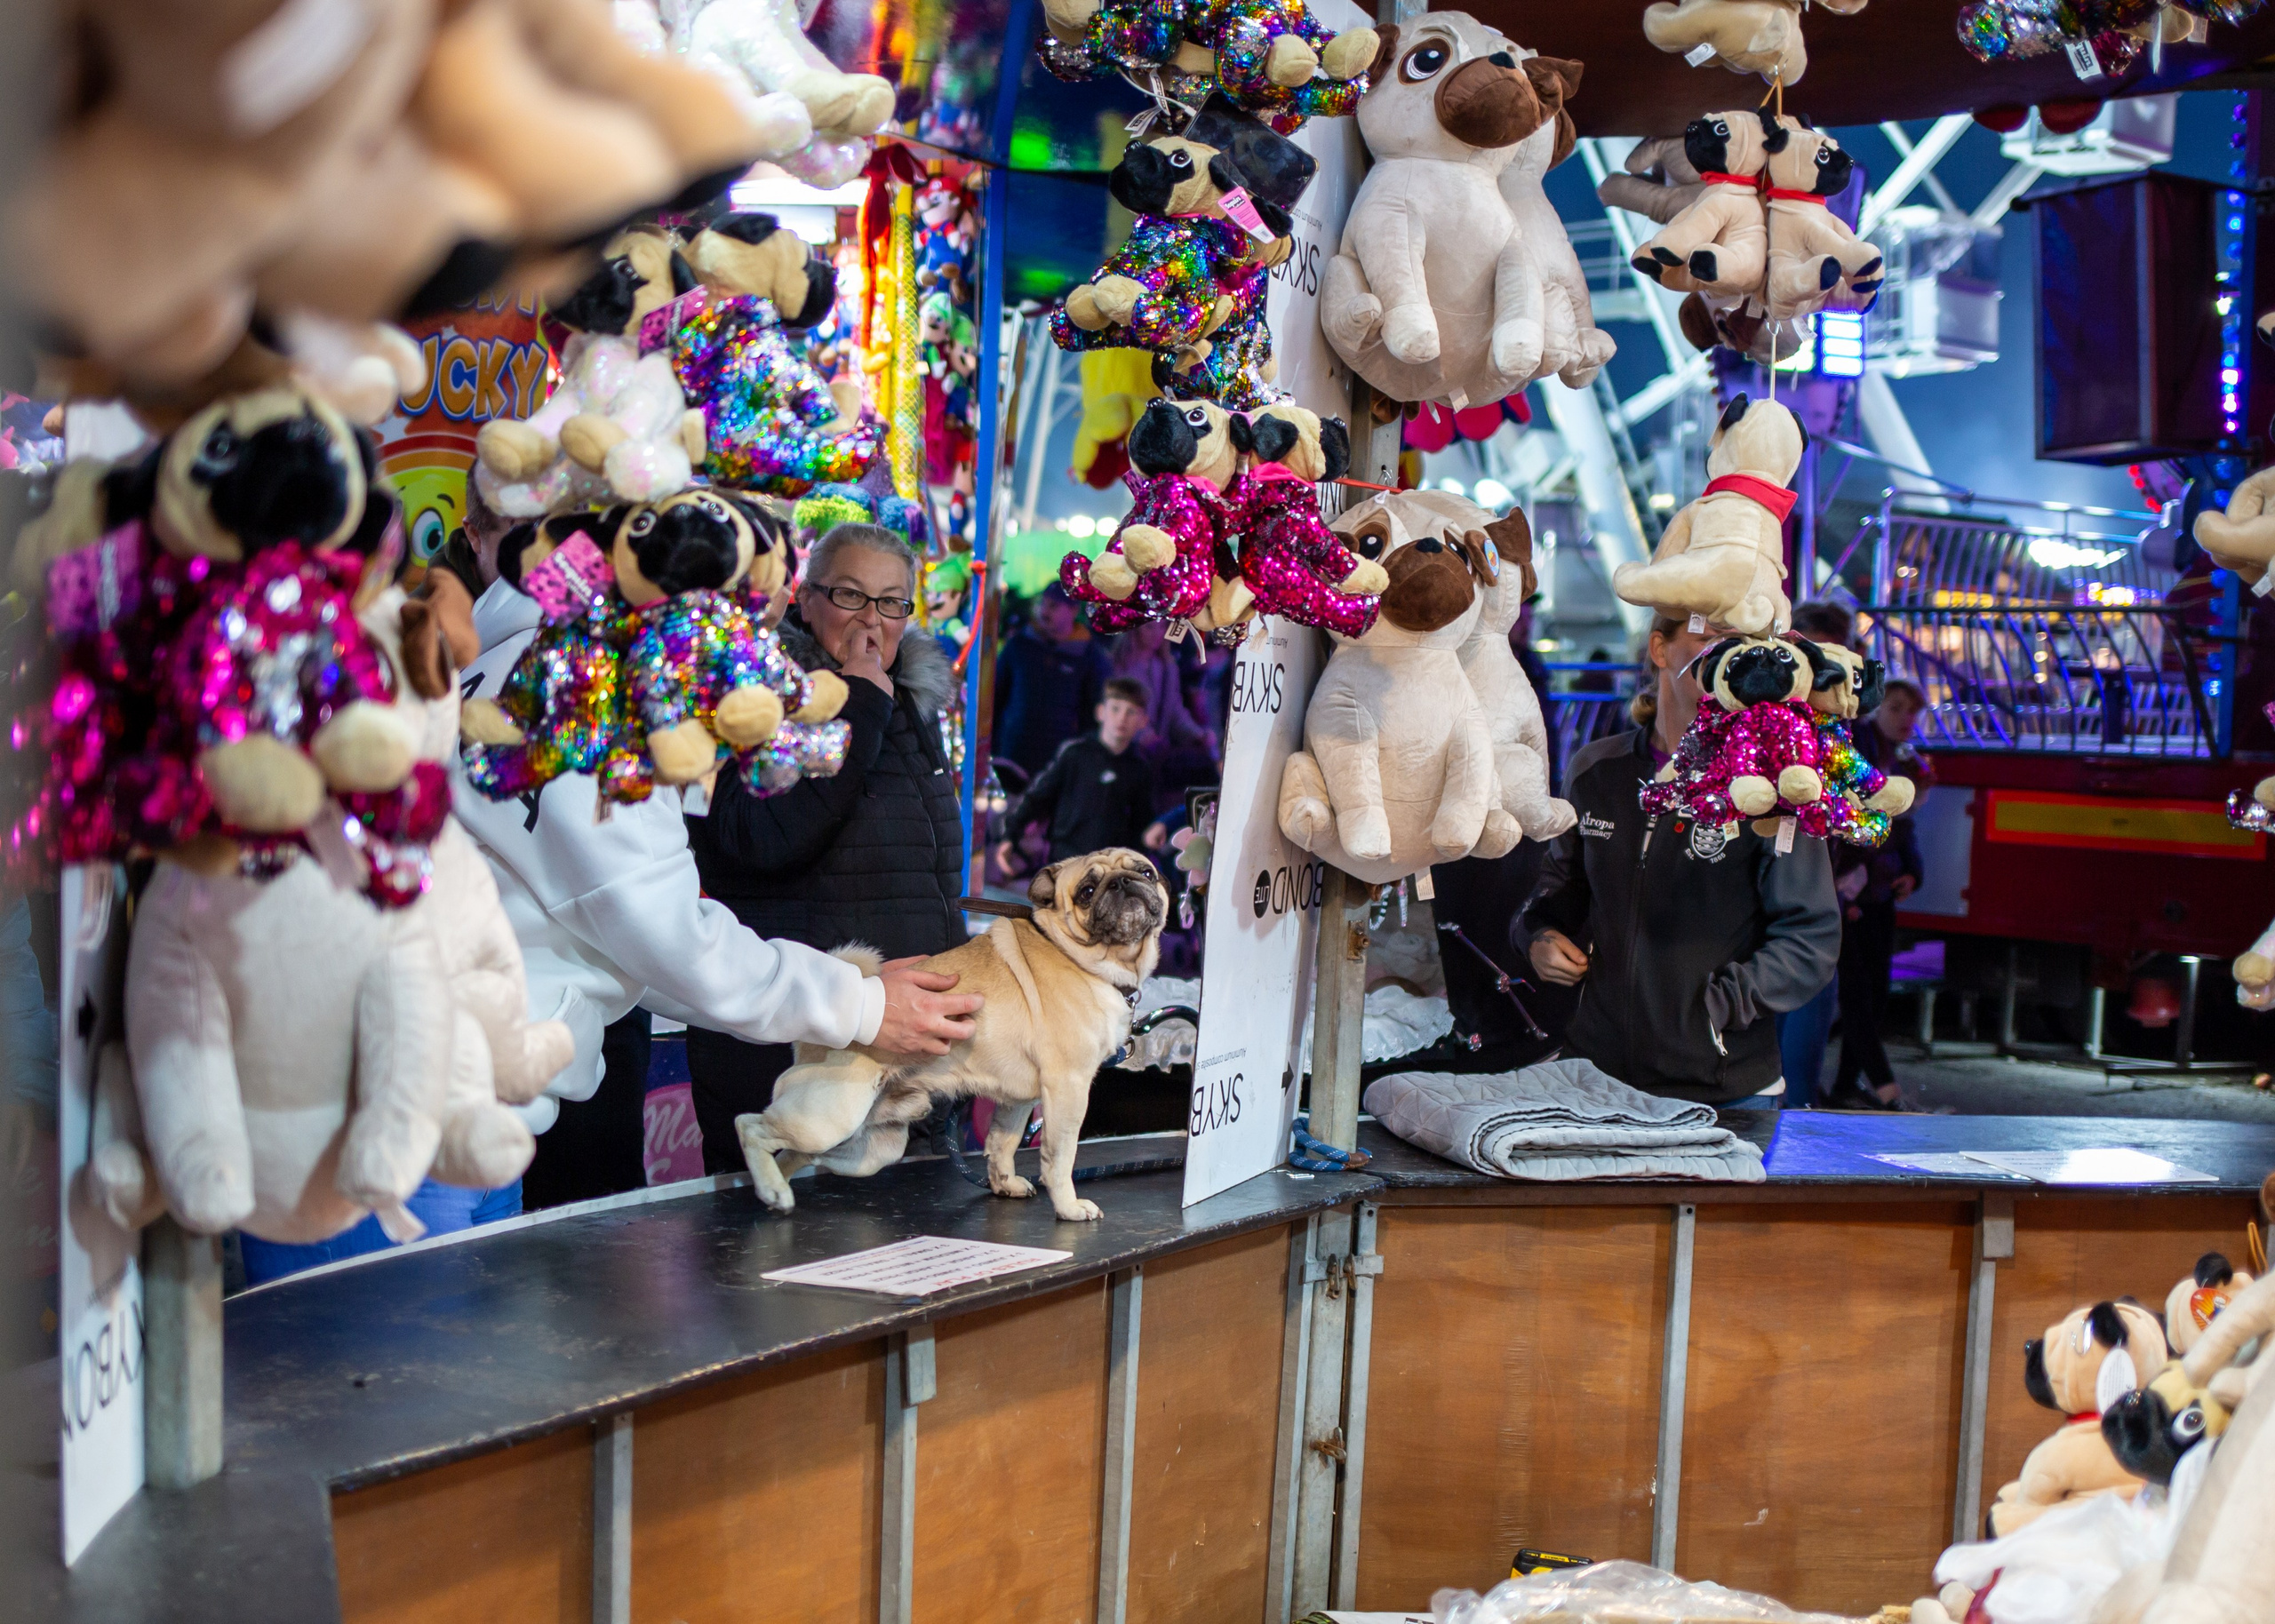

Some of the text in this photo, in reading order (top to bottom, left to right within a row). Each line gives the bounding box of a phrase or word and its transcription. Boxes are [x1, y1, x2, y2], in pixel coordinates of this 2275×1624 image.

[399, 332, 548, 422] UCKY
[1232, 661, 1285, 714] SKYB
[1254, 862, 1327, 915] BOND LITE
[1191, 1072, 1244, 1137] SKYB
